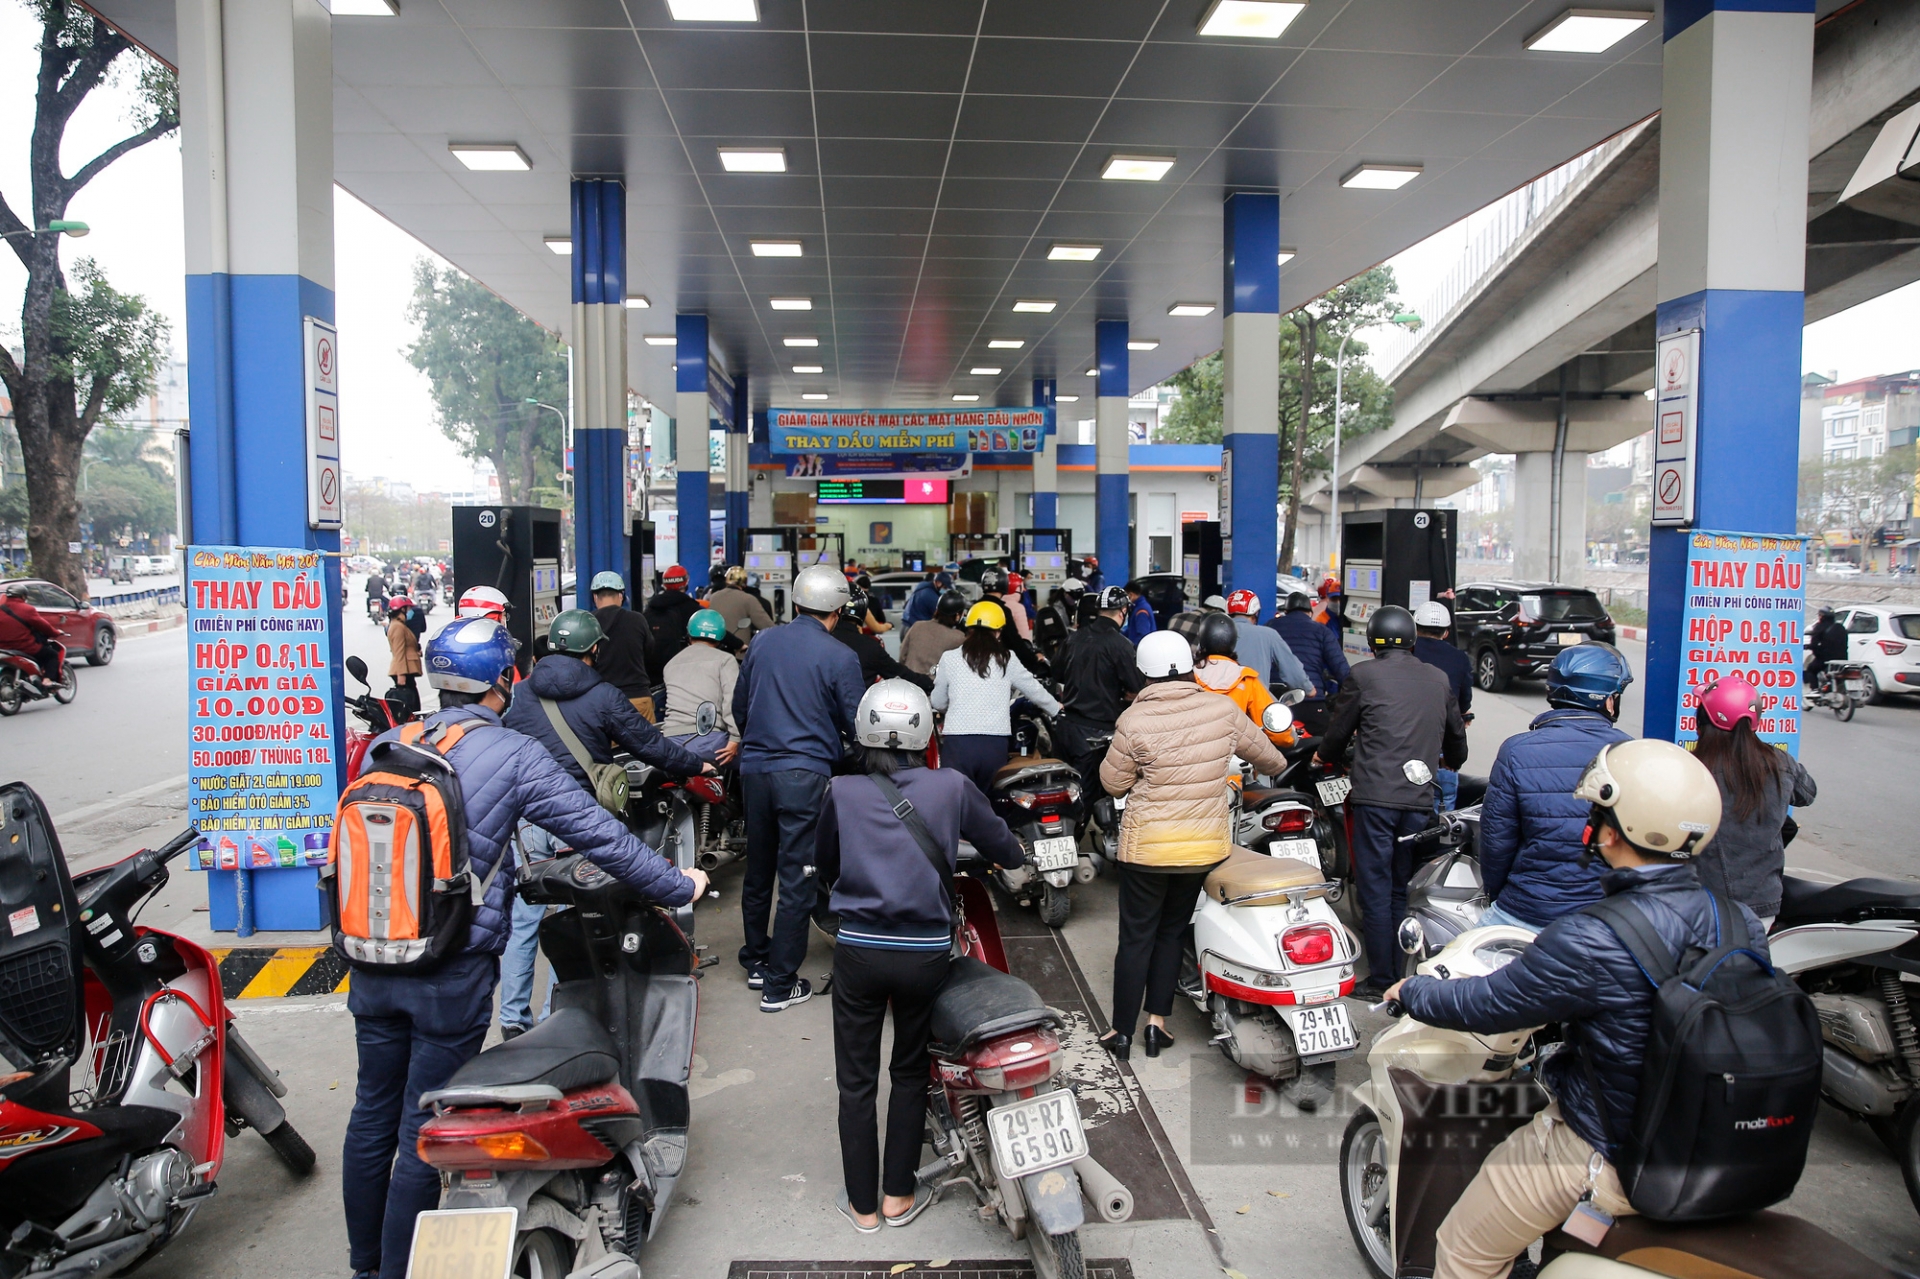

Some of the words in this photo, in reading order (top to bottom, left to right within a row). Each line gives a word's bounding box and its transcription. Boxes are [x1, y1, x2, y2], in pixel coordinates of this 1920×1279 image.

[778, 411, 807, 427] GIẢM
[810, 412, 829, 427] GIÁ
[832, 410, 875, 427] KHUYẾN
[903, 412, 924, 427] CÁC
[785, 435, 833, 449] THAY
[837, 430, 875, 449] DẦU
[879, 429, 921, 449] MIỄN
[926, 431, 956, 448] PHÍ
[480, 515, 494, 524] 20
[1416, 516, 1427, 525] 21
[1740, 536, 1760, 551] Năm
[193, 550, 220, 569] Chào
[223, 551, 251, 572] Mừng
[251, 553, 274, 569] Năm
[1690, 560, 1748, 588] THAY
[1755, 554, 1801, 590] DẦU
[192, 580, 263, 610] THAY
[272, 571, 322, 610] DẦU
[1690, 591, 1721, 608] (MIỄN
[1724, 594, 1742, 608] PHÍ
[1744, 595, 1772, 609] CÔNG
[1774, 598, 1802, 610] THAY)
[194, 614, 233, 632] (MIỄN
[236, 616, 256, 632] PHÍ
[260, 616, 294, 632] CÔNG
[1689, 614, 1733, 647] HỘP
[1740, 620, 1800, 646] 0.8,1L
[196, 638, 248, 674] HỘP
[255, 643, 325, 671] 0.8,1L
[1688, 646, 1749, 663] GIẢM
[1757, 649, 1793, 664] GIÁ
[197, 673, 269, 691] GIẢM
[276, 674, 318, 690] GIÁ
[197, 696, 325, 717] 10.000Đ
[1782, 696, 1798, 710] 4L
[193, 721, 304, 743] 30.000Đ/HỘP
[309, 723, 330, 739] 4L
[1778, 718, 1797, 732] 18L
[193, 749, 257, 767] 50.000Đ/
[260, 746, 303, 764] THÙNG
[306, 748, 331, 764] 18L
[200, 774, 227, 791] NƯỚC
[229, 772, 251, 791] GIẶT
[252, 776, 264, 789] 2L
[266, 771, 289, 789] GIẢM
[290, 774, 322, 788] 19.000
[1323, 780, 1348, 793] 18-L1
[200, 794, 220, 812] BẢO
[222, 792, 247, 810] HIỂM
[249, 793, 267, 809] ÔTÔ
[269, 791, 292, 809] GIẢM
[293, 795, 310, 809] 3%
[200, 814, 220, 832] BẢO
[222, 812, 247, 831] HIỂM
[249, 816, 261, 830] XE
[263, 814, 284, 830] MÁY
[285, 812, 311, 829] GIẢM
[313, 814, 335, 828] 10%
[1040, 840, 1071, 855] 37-B2
[1277, 842, 1310, 857] 36-B6
[1299, 1006, 1342, 1031] 29-M1
[1299, 1027, 1351, 1052] 570.84
[1009, 1051, 1036, 1062] HONDA
[1011, 1128, 1074, 1168] 6590
